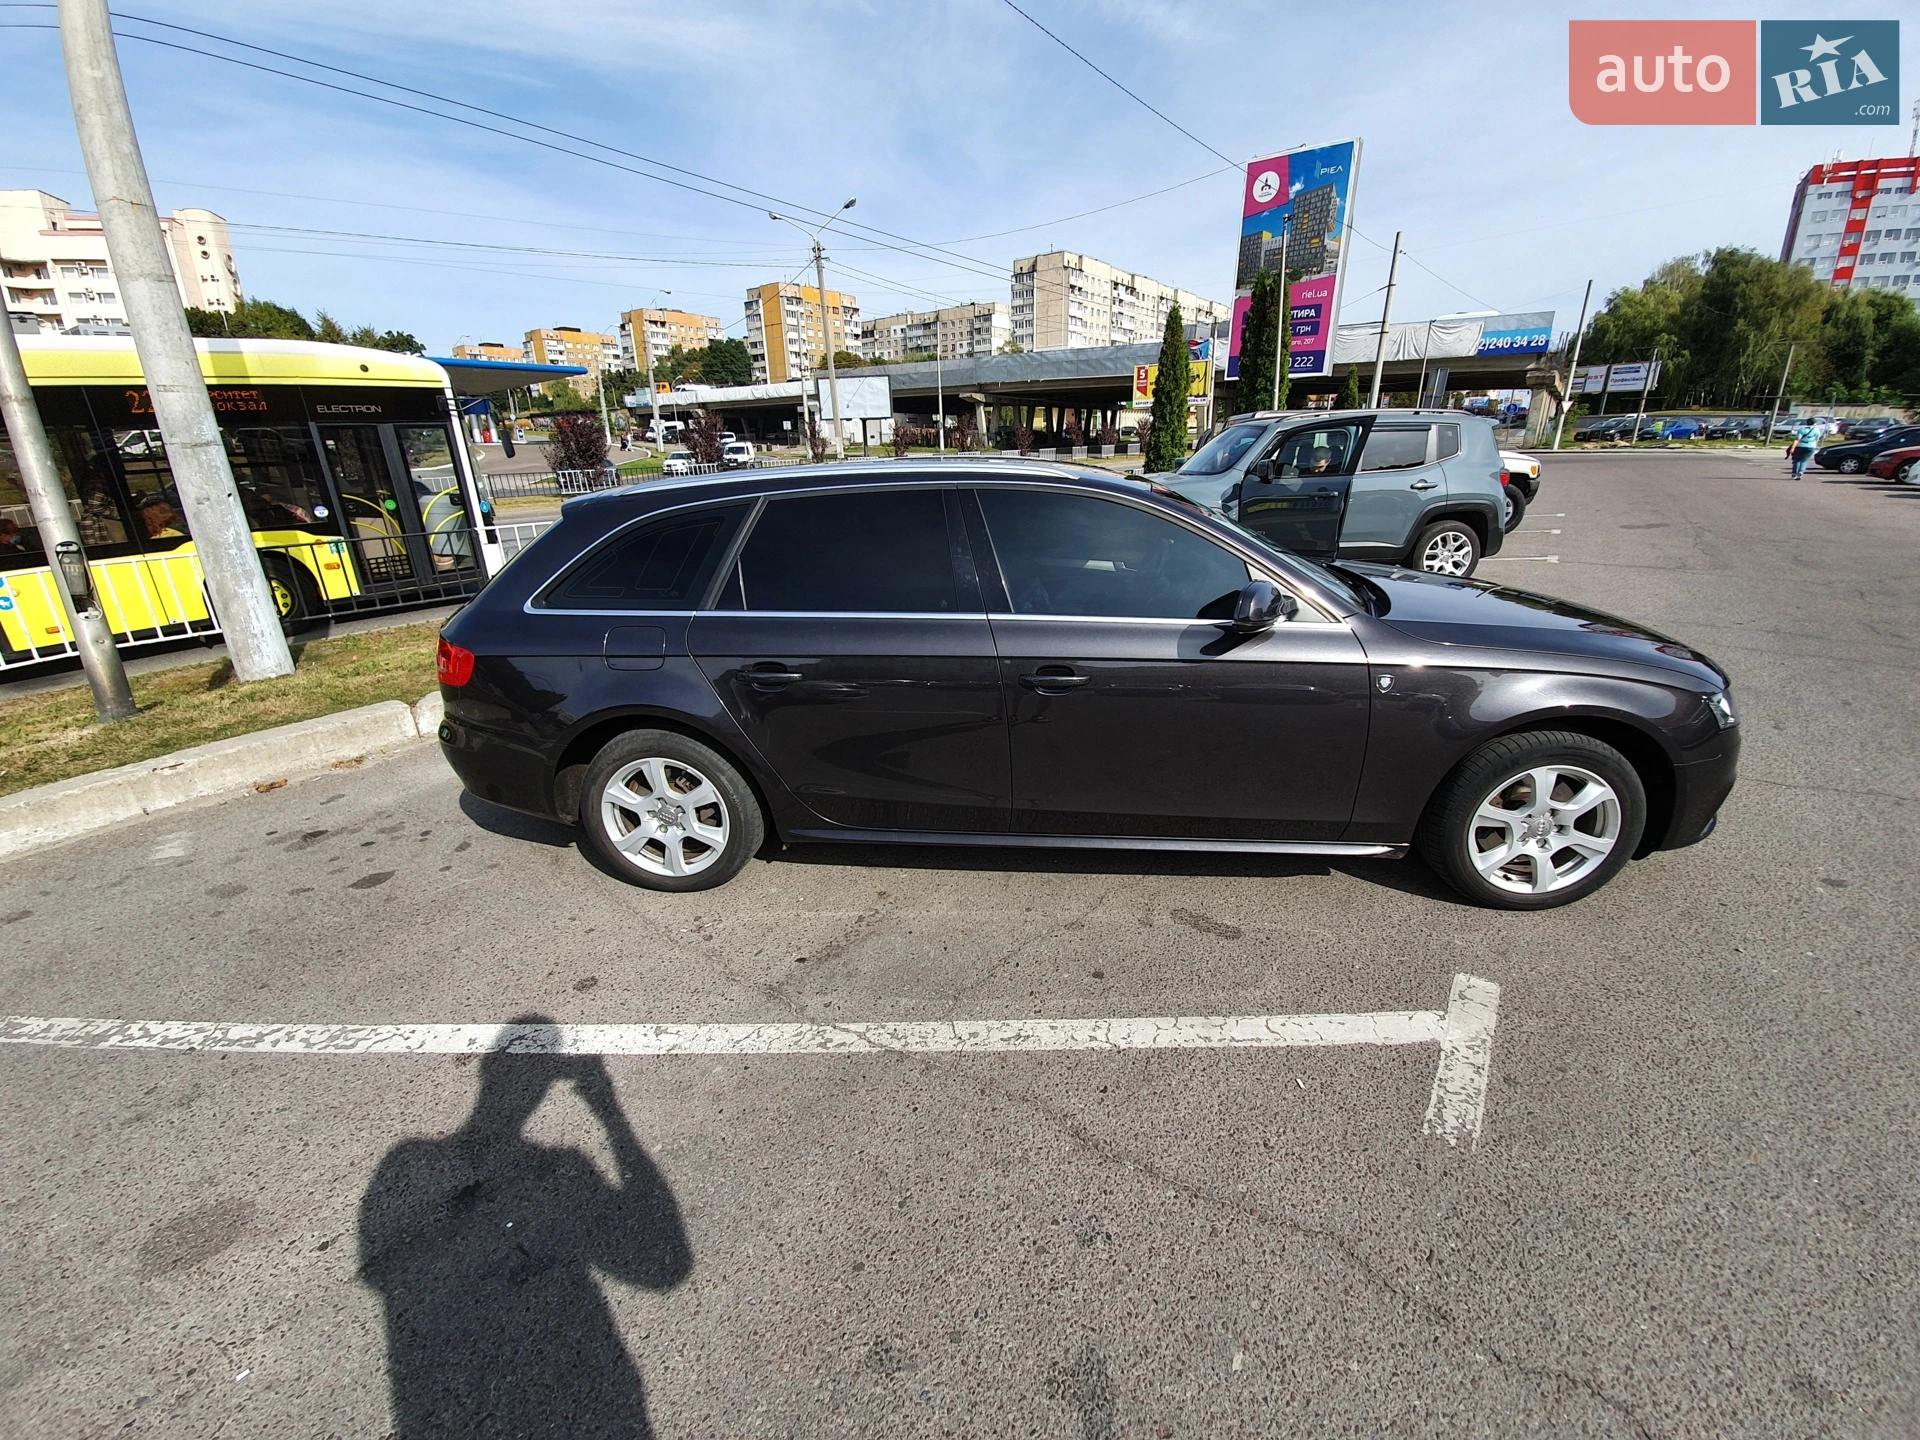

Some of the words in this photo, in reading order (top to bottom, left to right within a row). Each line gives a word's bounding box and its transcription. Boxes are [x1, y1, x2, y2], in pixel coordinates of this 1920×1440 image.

[1302, 289, 1328, 299] riel.ua
[1296, 325, 1312, 335] грн
[1513, 335, 1528, 348] 34
[1530, 334, 1547, 347] 28
[1294, 356, 1314, 368] 222
[1139, 369, 1146, 379] 5
[212, 401, 268, 411] окзал
[316, 404, 382, 413] ELECTRON
